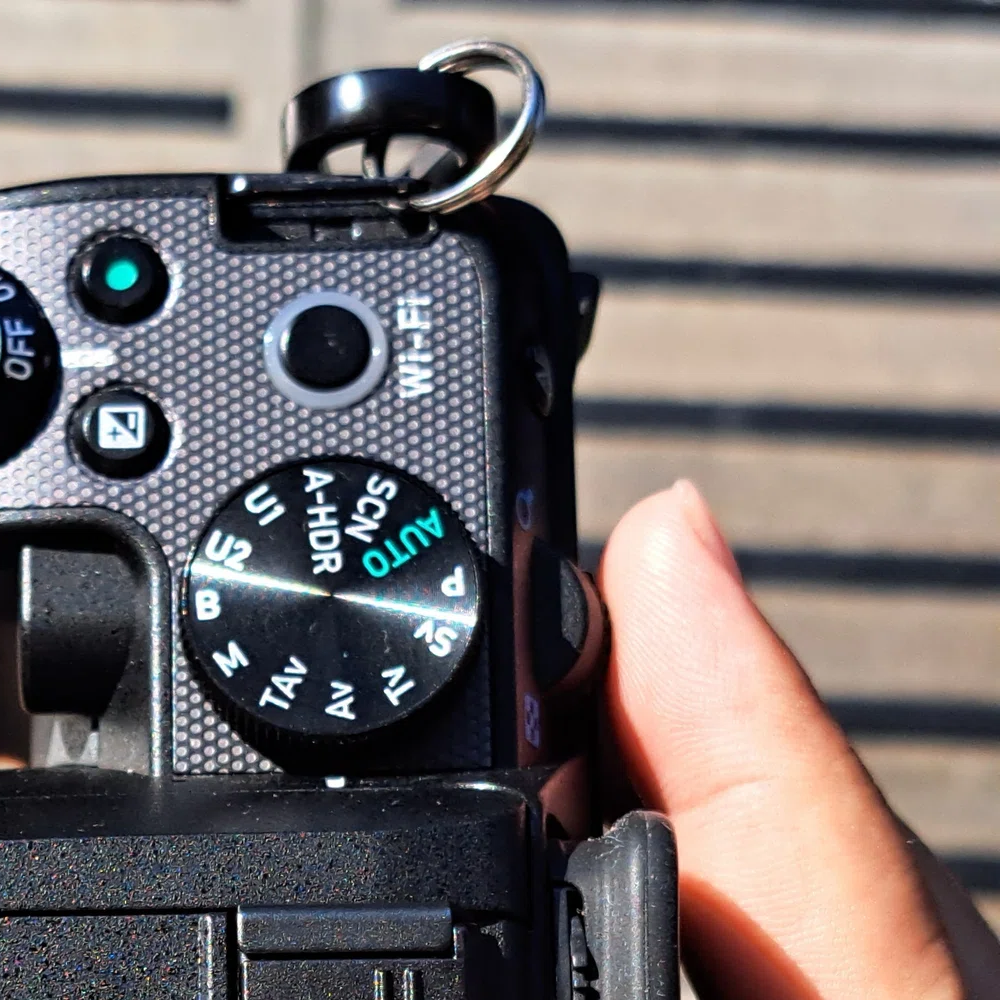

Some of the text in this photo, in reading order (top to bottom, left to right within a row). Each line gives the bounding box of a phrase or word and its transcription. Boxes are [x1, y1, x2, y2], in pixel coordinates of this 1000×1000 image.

[3, 319, 36, 381] OFF
[397, 295, 434, 399] Wi-Fi
[244, 484, 287, 526] U1
[303, 467, 344, 575] A-HDR
[344, 474, 399, 544] SCN
[204, 529, 252, 572] U2
[361, 508, 446, 579] AUTO
[194, 588, 222, 622] B
[440, 565, 465, 598] P
[211, 639, 250, 679] M
